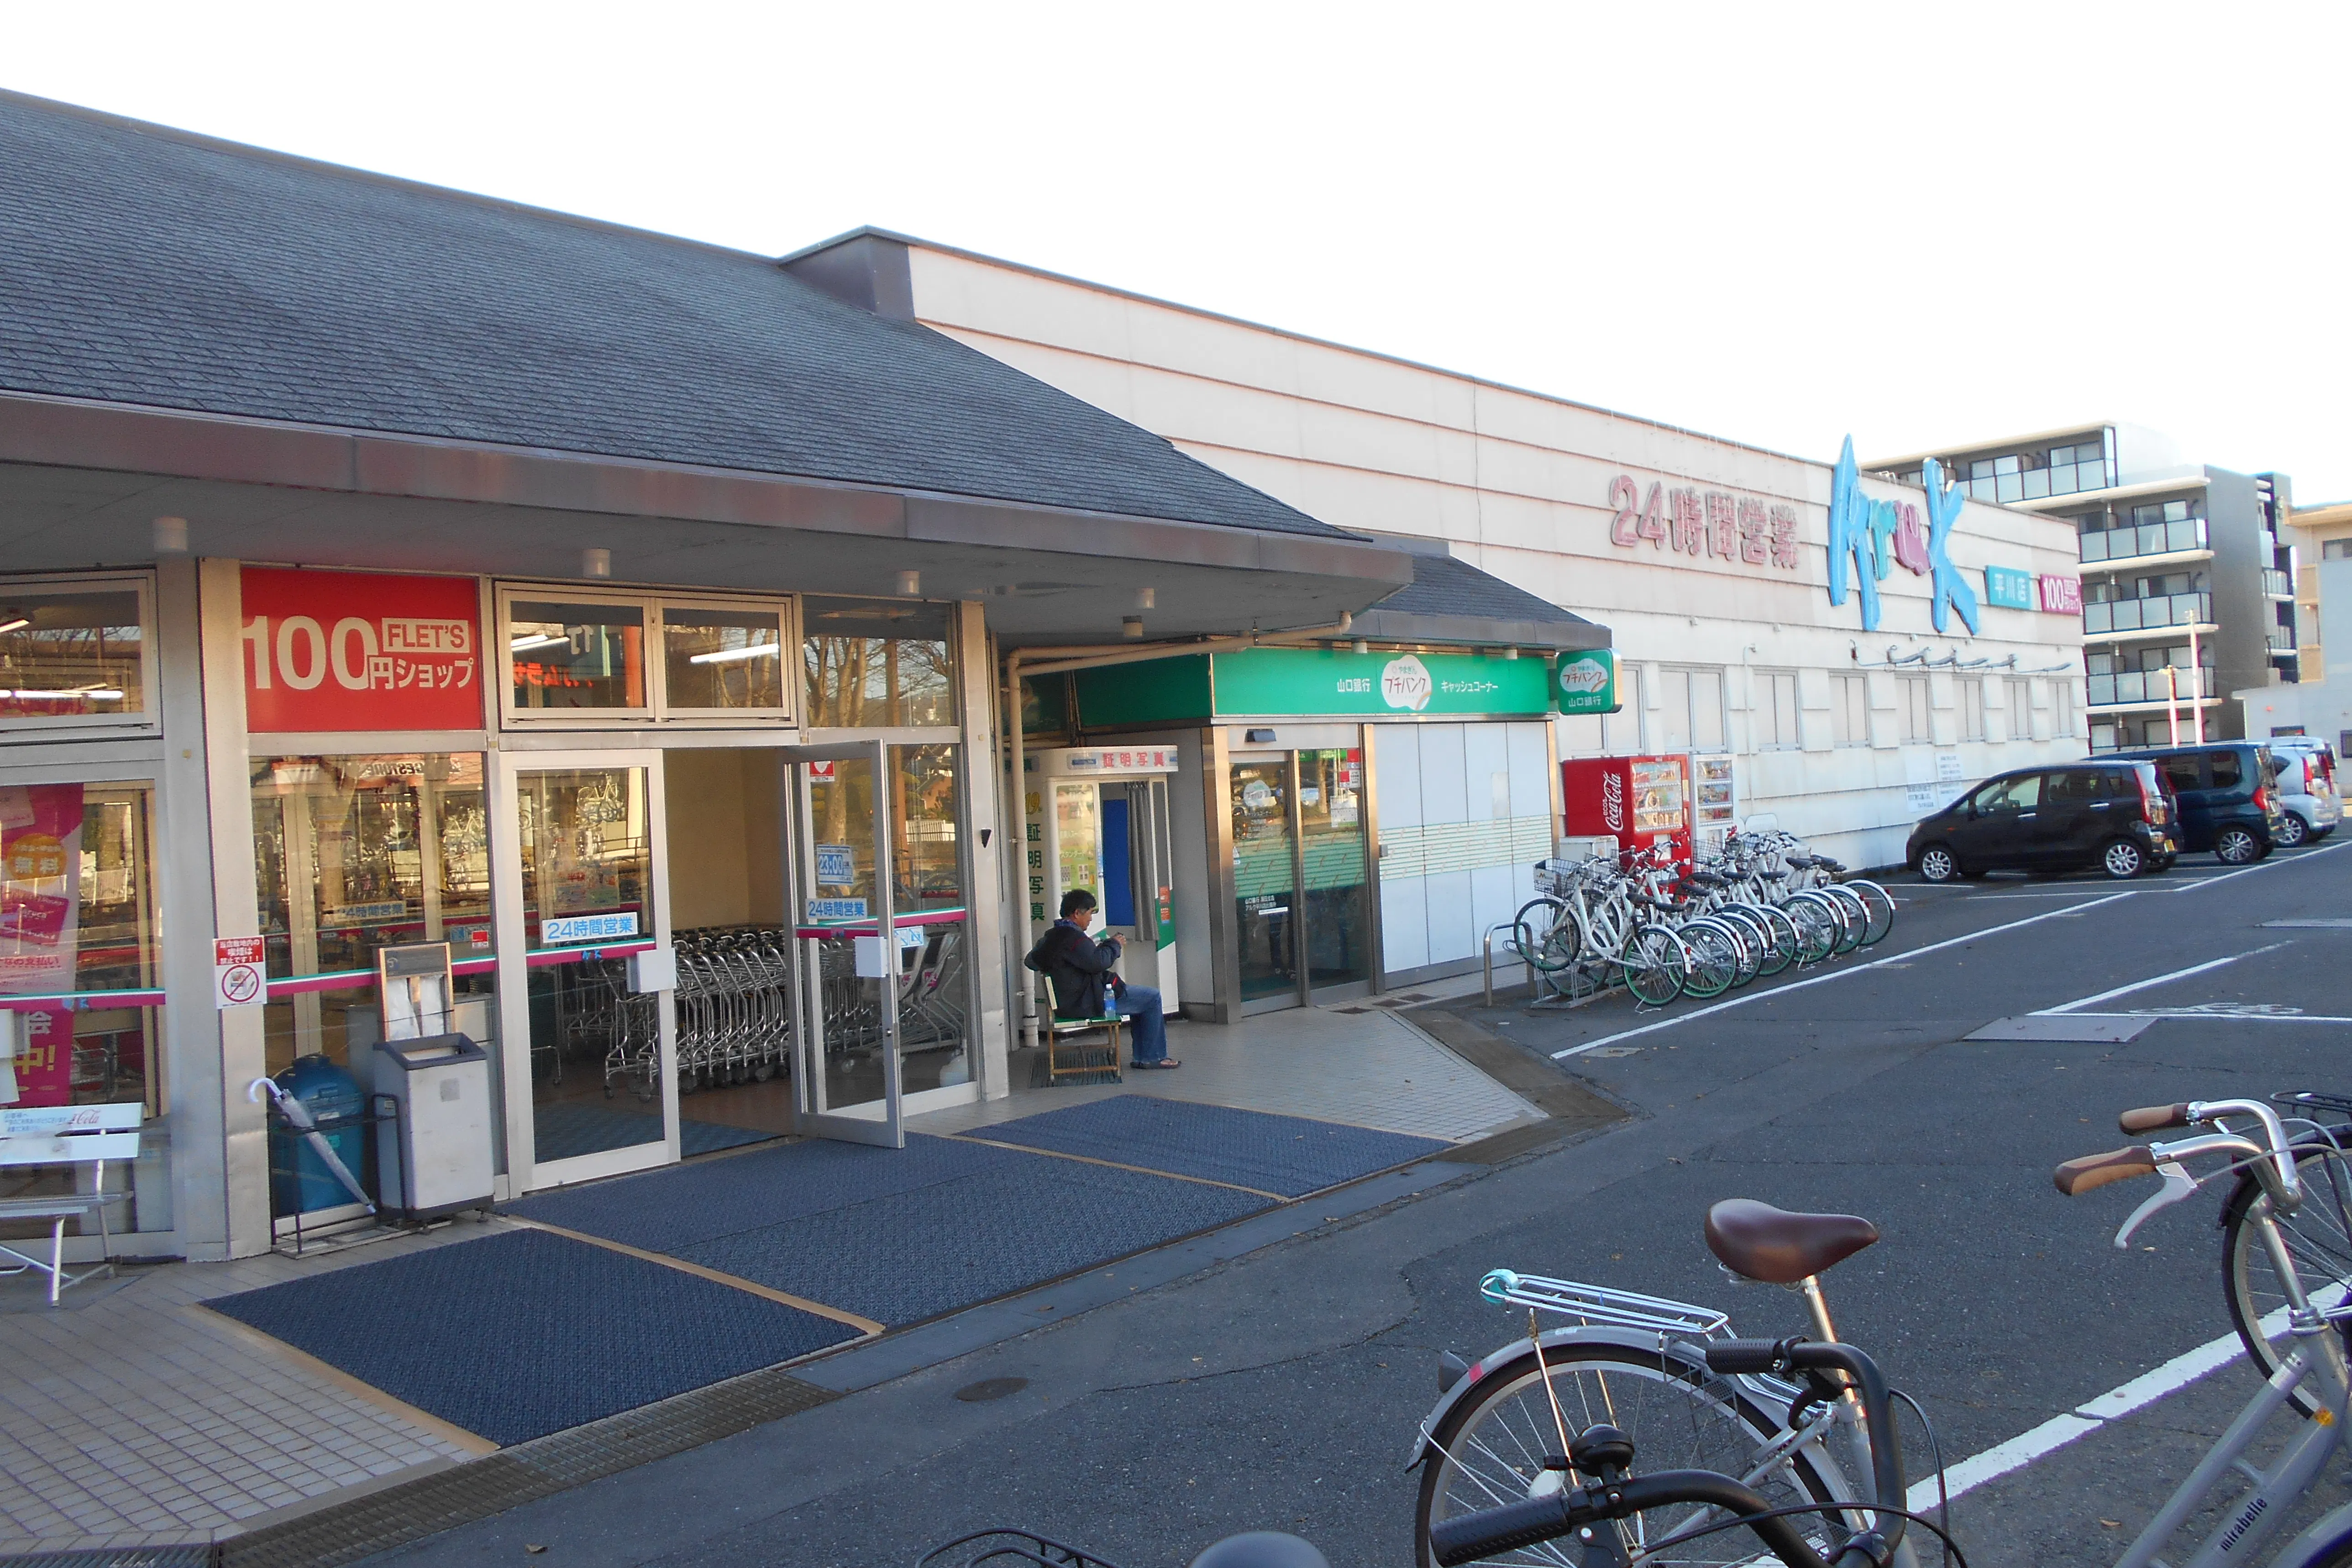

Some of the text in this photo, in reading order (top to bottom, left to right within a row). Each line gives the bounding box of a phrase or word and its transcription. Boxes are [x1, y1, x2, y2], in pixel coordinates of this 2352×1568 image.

[1609, 474, 1800, 569] 24時間営業
[2043, 577, 2064, 610] 100
[387, 624, 465, 649] FLET'S
[242, 615, 378, 690] 100
[369, 656, 474, 690] 円ショップ
[1563, 671, 1602, 684] プチバンク
[1337, 678, 1370, 692] 山口銀行
[1384, 676, 1426, 694] プチバンク
[1440, 680, 1499, 693] キャッシュコーナー
[1568, 695, 1601, 707] 山口銀行
[1103, 751, 1165, 768] 証明写真
[1603, 770, 1624, 831] Coca-Cola
[819, 855, 843, 875] 23:00
[1026, 823, 1045, 921] 証明写真
[808, 901, 865, 917] 24時間営業
[547, 916, 633, 939] 24時間営業
[2220, 1496, 2268, 1552] mirabelle
